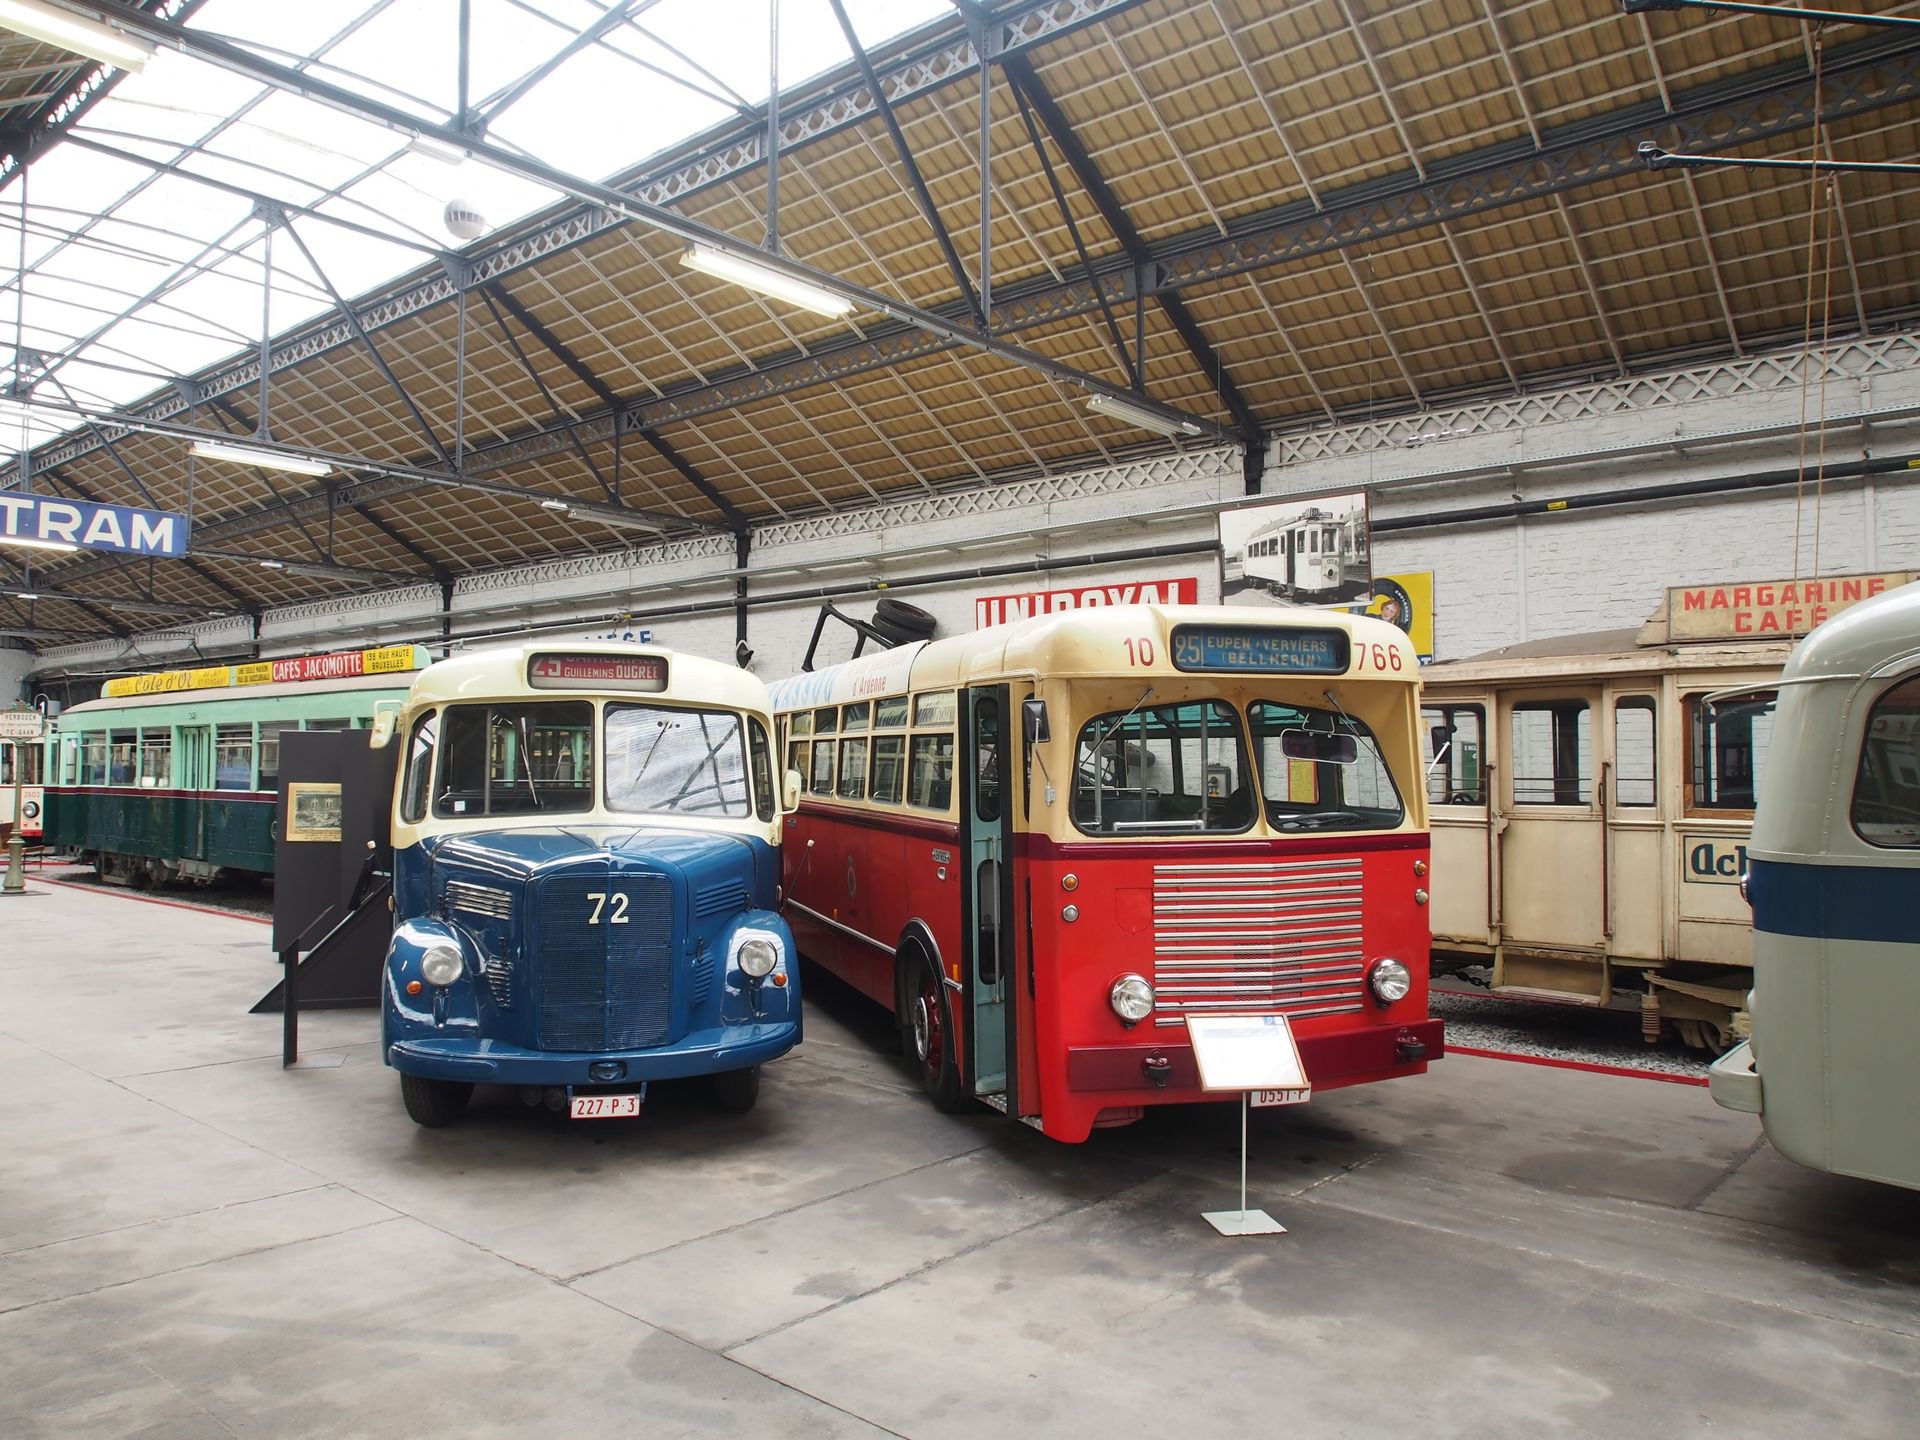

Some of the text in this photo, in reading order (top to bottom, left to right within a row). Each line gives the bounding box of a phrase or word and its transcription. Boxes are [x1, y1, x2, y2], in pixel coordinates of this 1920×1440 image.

[0, 497, 174, 553] TRAM
[1683, 578, 1885, 611] MARGARINE
[1735, 606, 1828, 635] CAFÉ
[379, 650, 390, 659] RUE
[391, 649, 409, 657] HAUTE
[1124, 637, 1155, 667] 10
[1175, 635, 1200, 662] 25
[1207, 636, 1328, 651] EUPEN VERVIERS
[1353, 642, 1402, 671] 766
[372, 660, 404, 671] BRUXELLES
[564, 667, 614, 678] GUILLEMINS
[587, 892, 629, 924] 72
